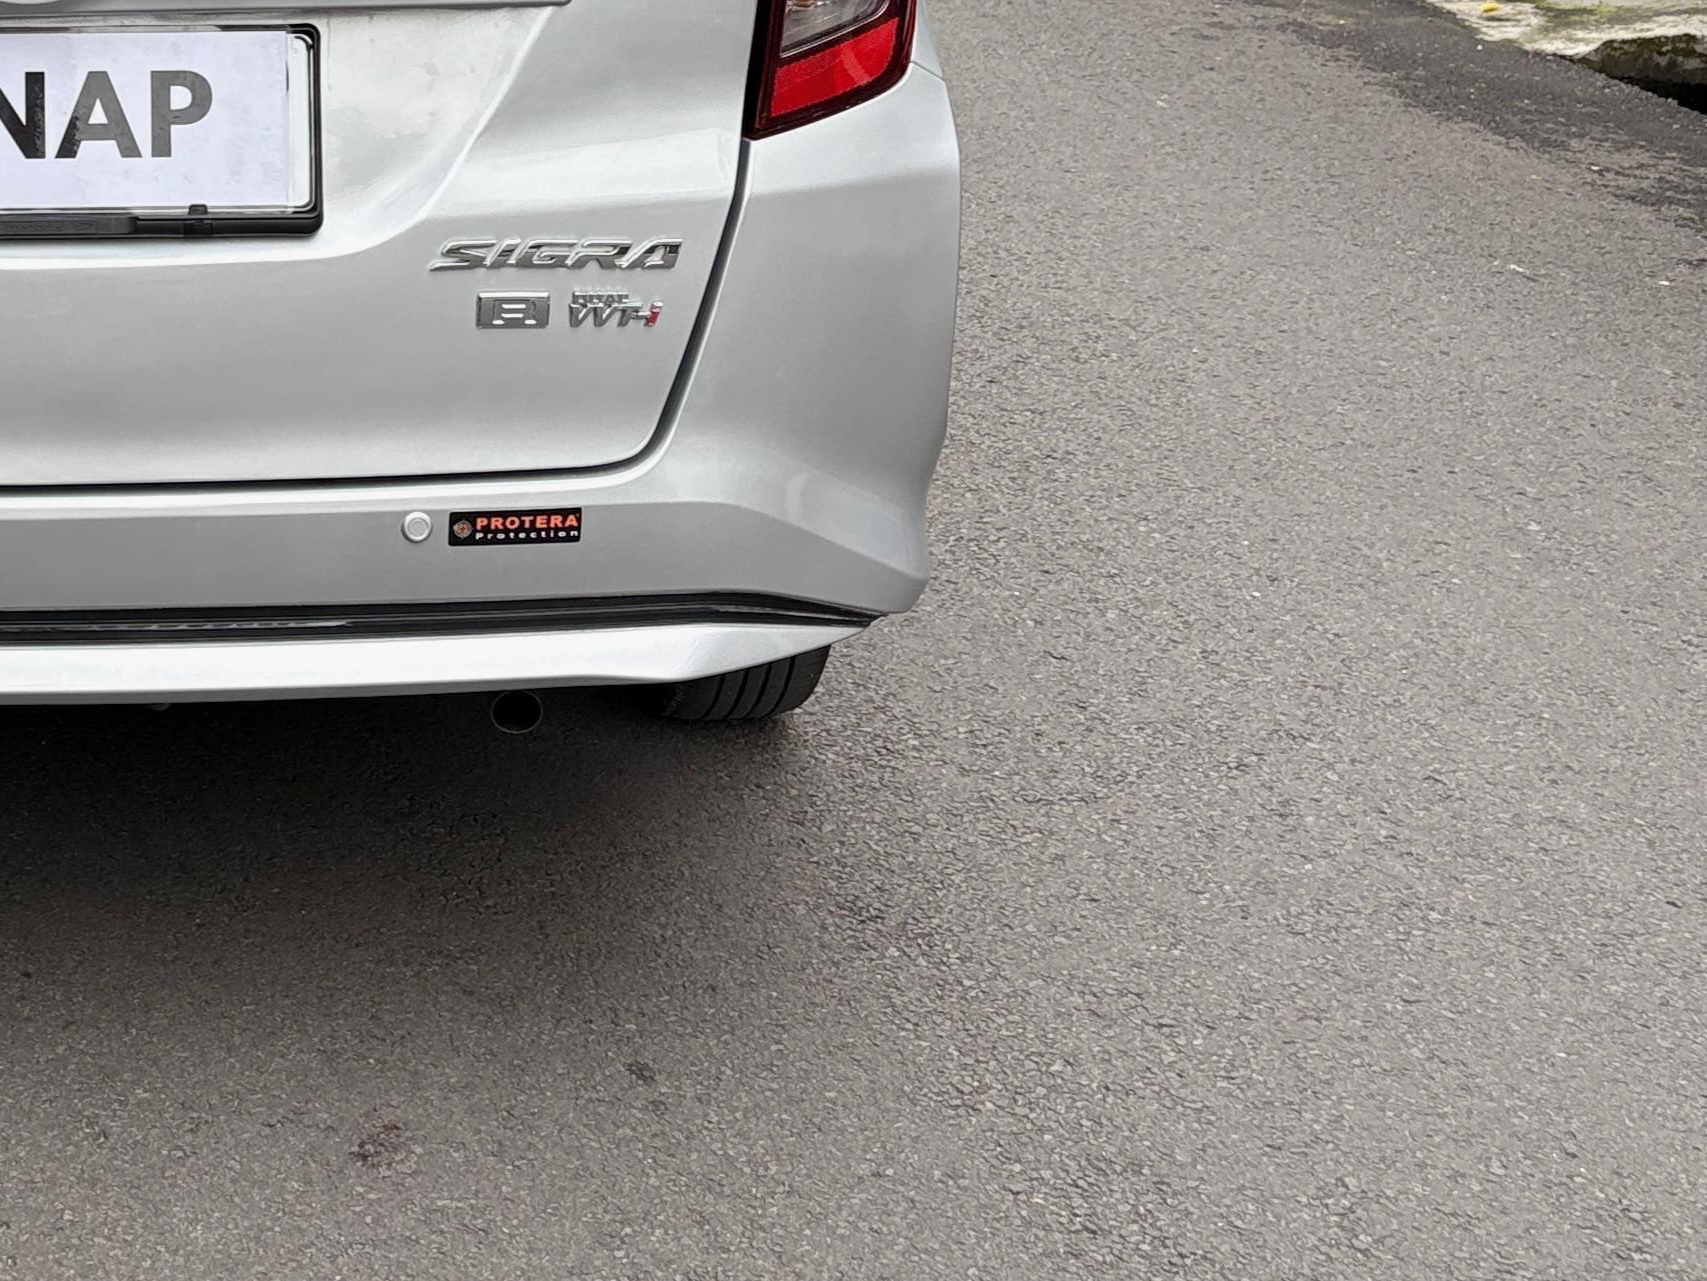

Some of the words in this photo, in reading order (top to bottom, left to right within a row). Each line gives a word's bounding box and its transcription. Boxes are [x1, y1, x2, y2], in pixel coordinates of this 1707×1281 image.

[428, 238, 683, 270] SIGRA
[476, 514, 579, 531] PROTERA
[475, 529, 579, 540] Protection
